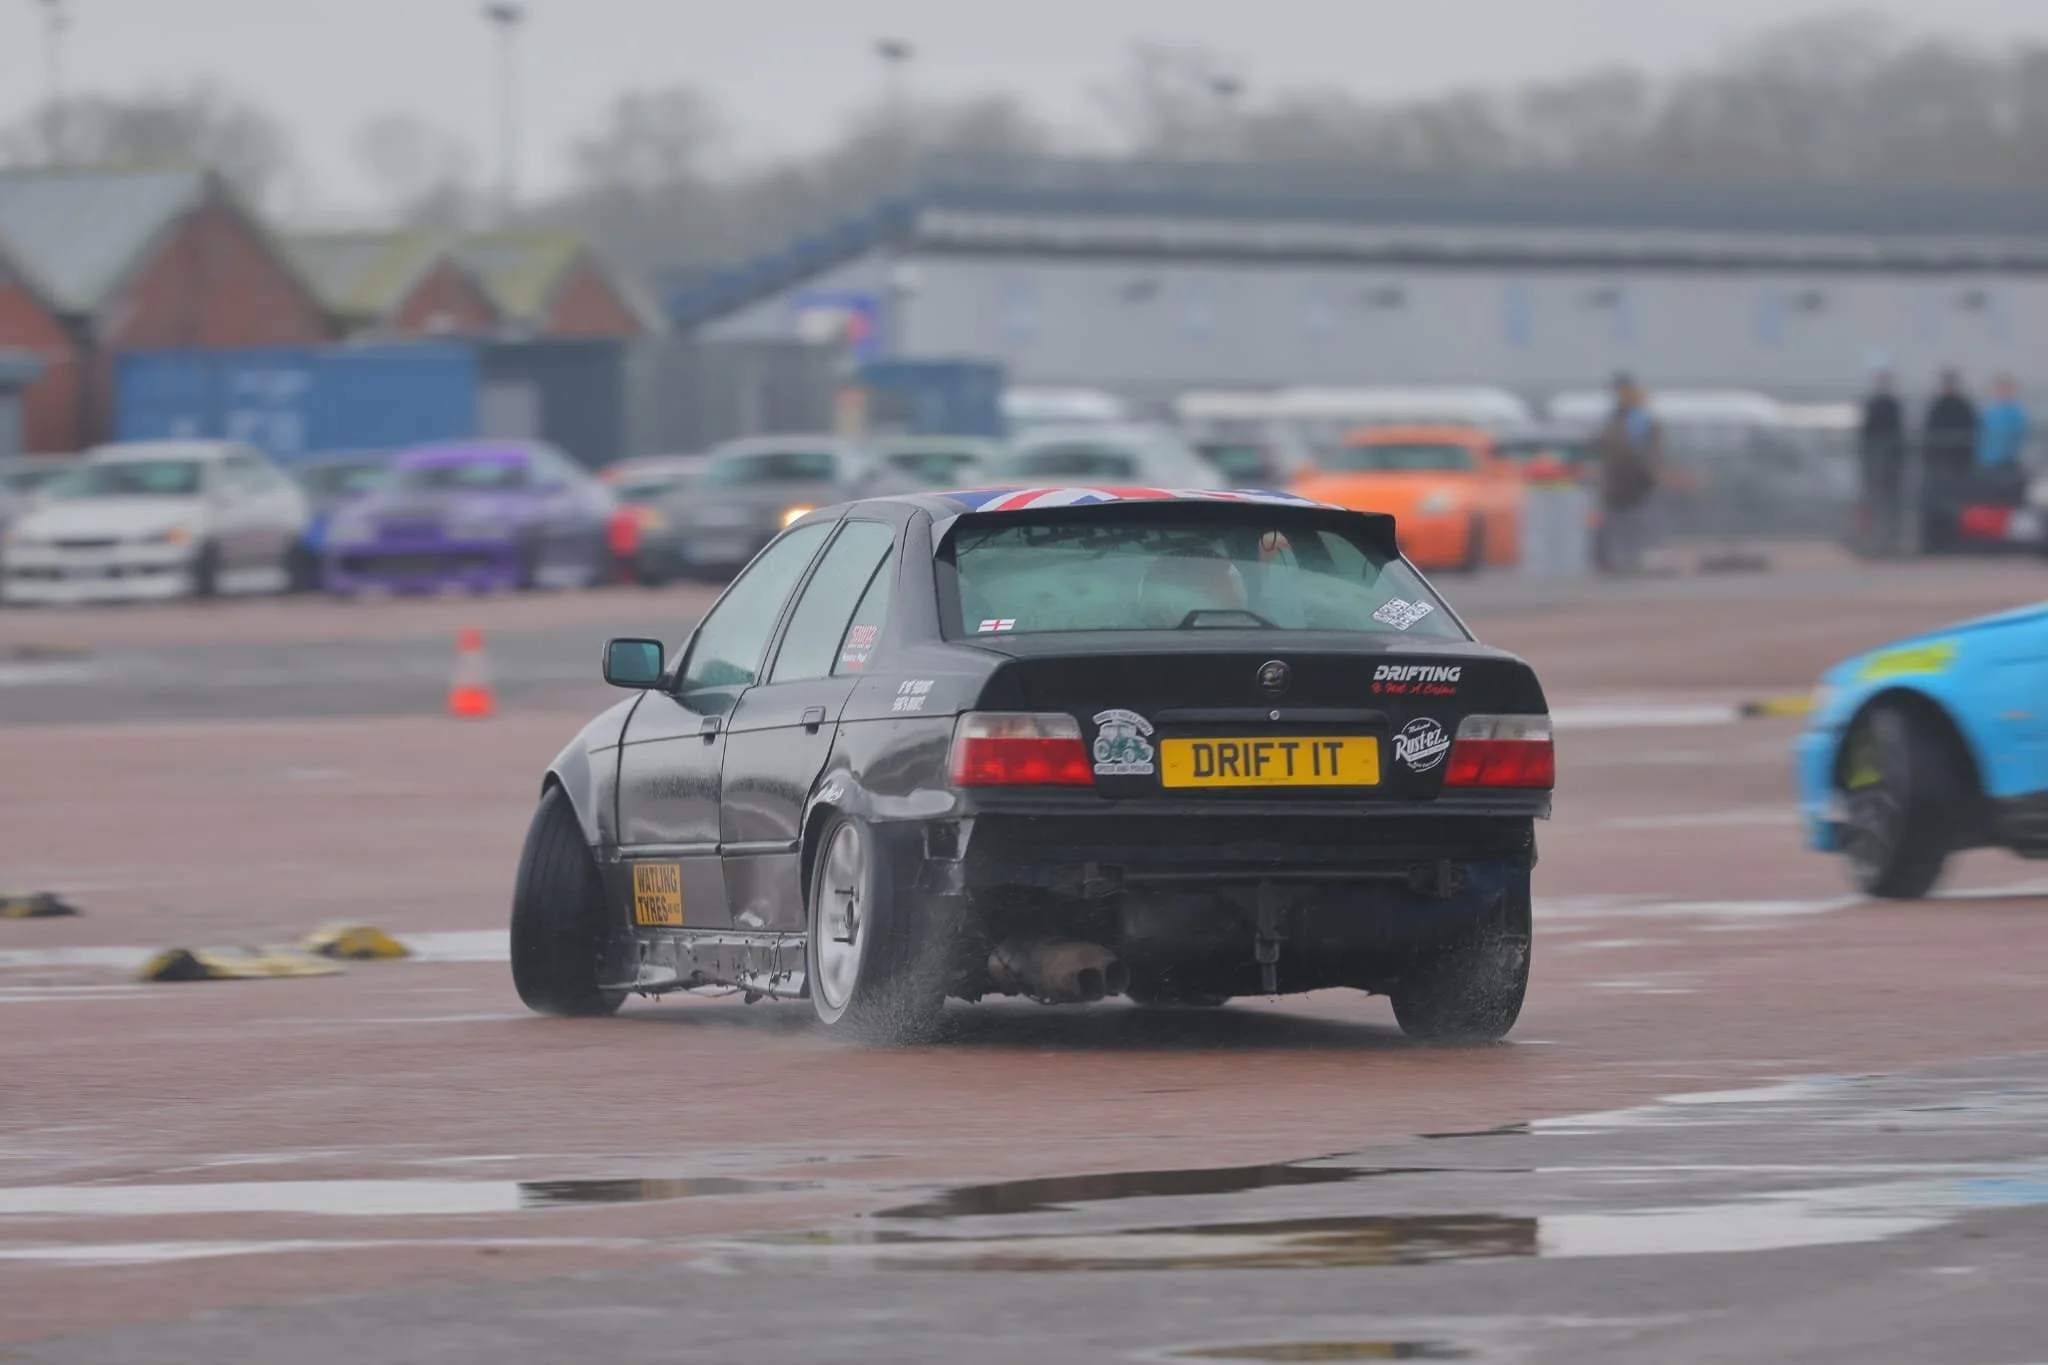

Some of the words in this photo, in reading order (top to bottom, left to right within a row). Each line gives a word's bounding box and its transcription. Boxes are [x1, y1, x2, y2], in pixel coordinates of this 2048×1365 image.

[1373, 665, 1462, 682] DRIFTING
[1410, 683, 1422, 694] A
[1192, 742, 1300, 777] DRIFT
[1312, 742, 1344, 776] IT
[636, 866, 678, 893] WATLING
[637, 895, 669, 922] TYRES
